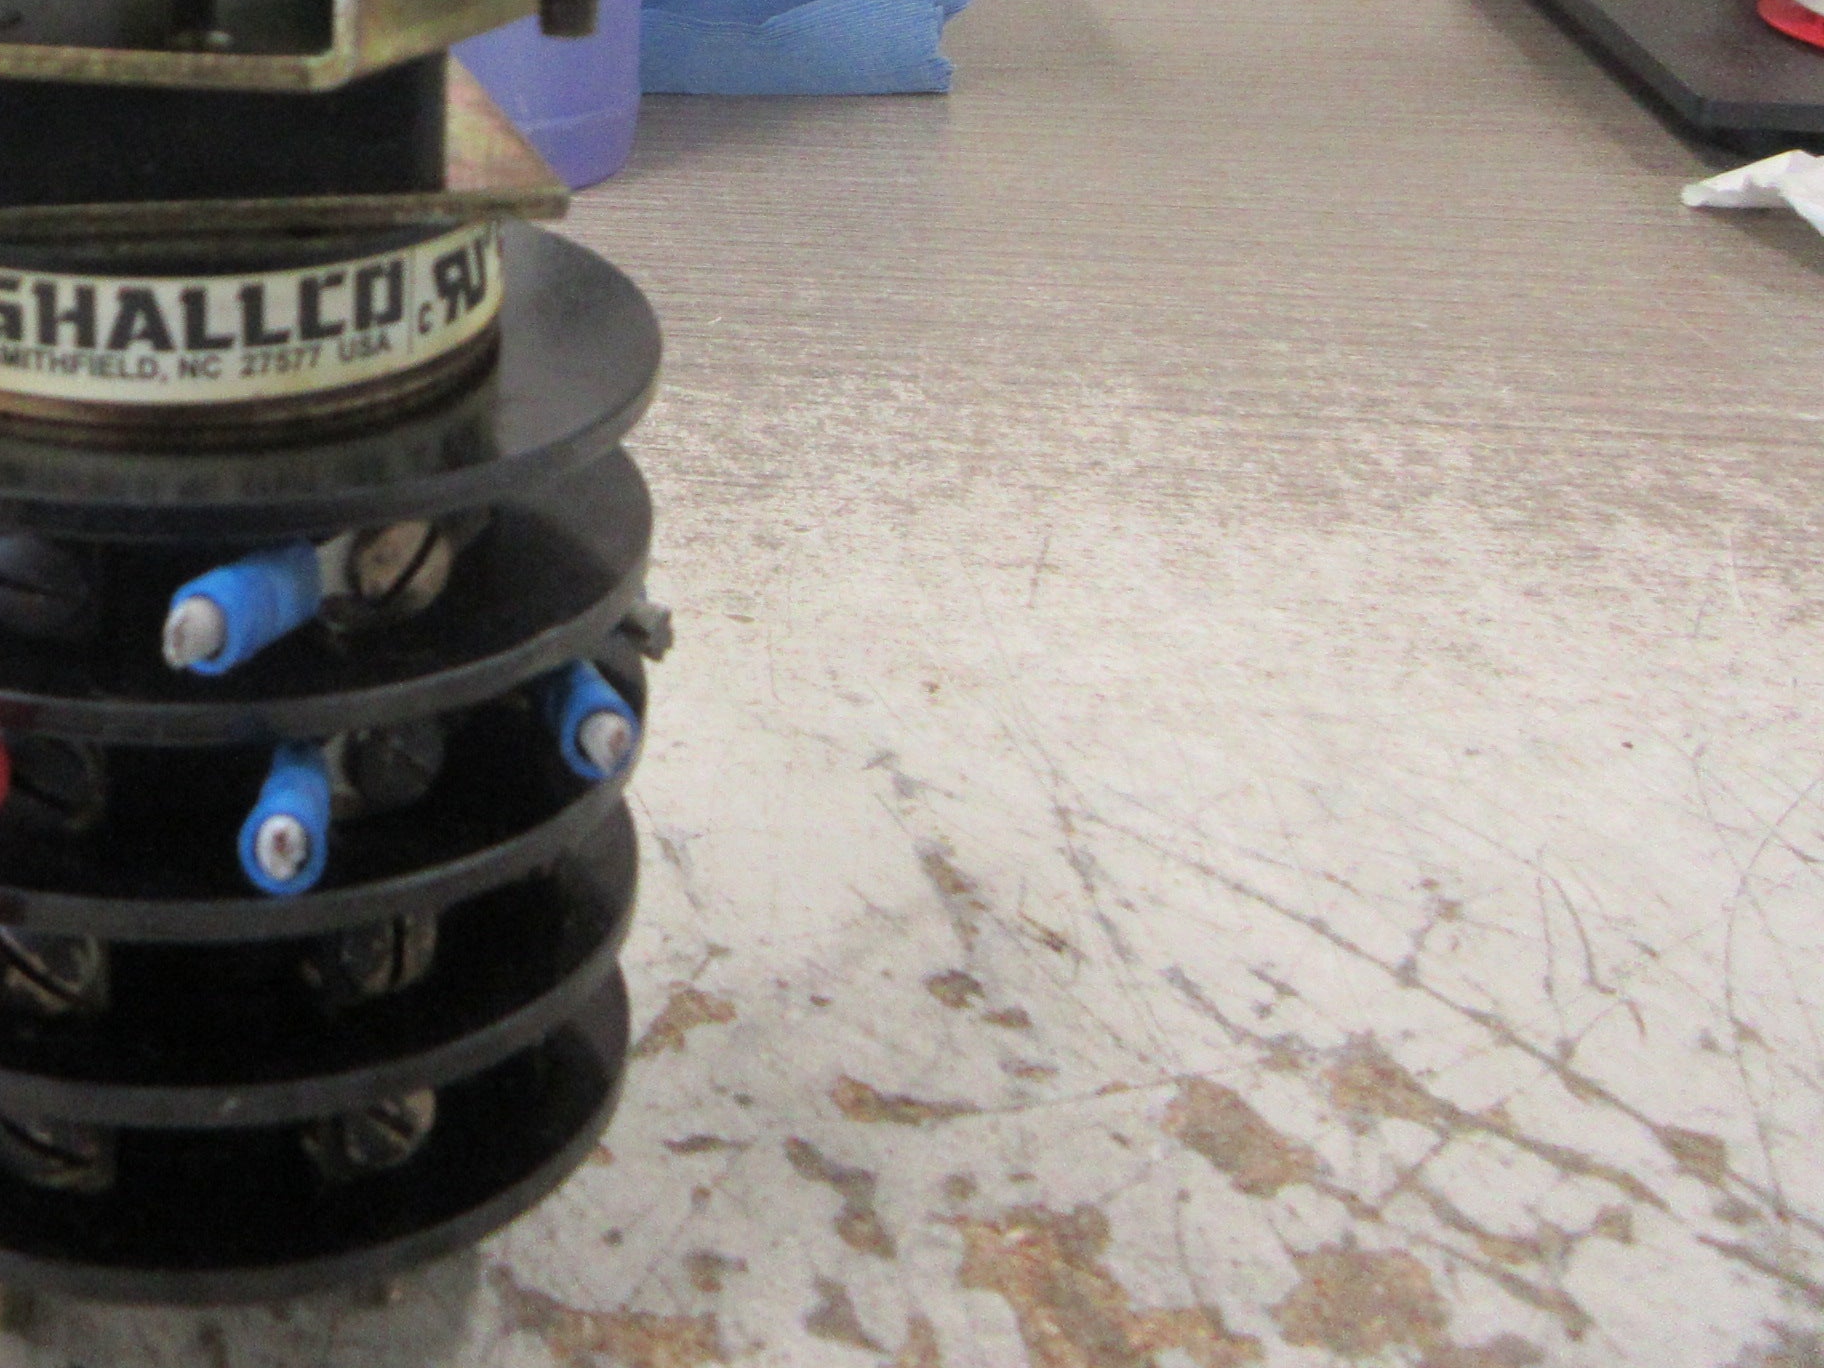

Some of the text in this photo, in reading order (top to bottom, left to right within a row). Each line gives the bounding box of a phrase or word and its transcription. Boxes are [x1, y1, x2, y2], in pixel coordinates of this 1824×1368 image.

[178, 353, 223, 381] NC
[239, 344, 323, 378] 27577
[337, 332, 393, 363] USA
